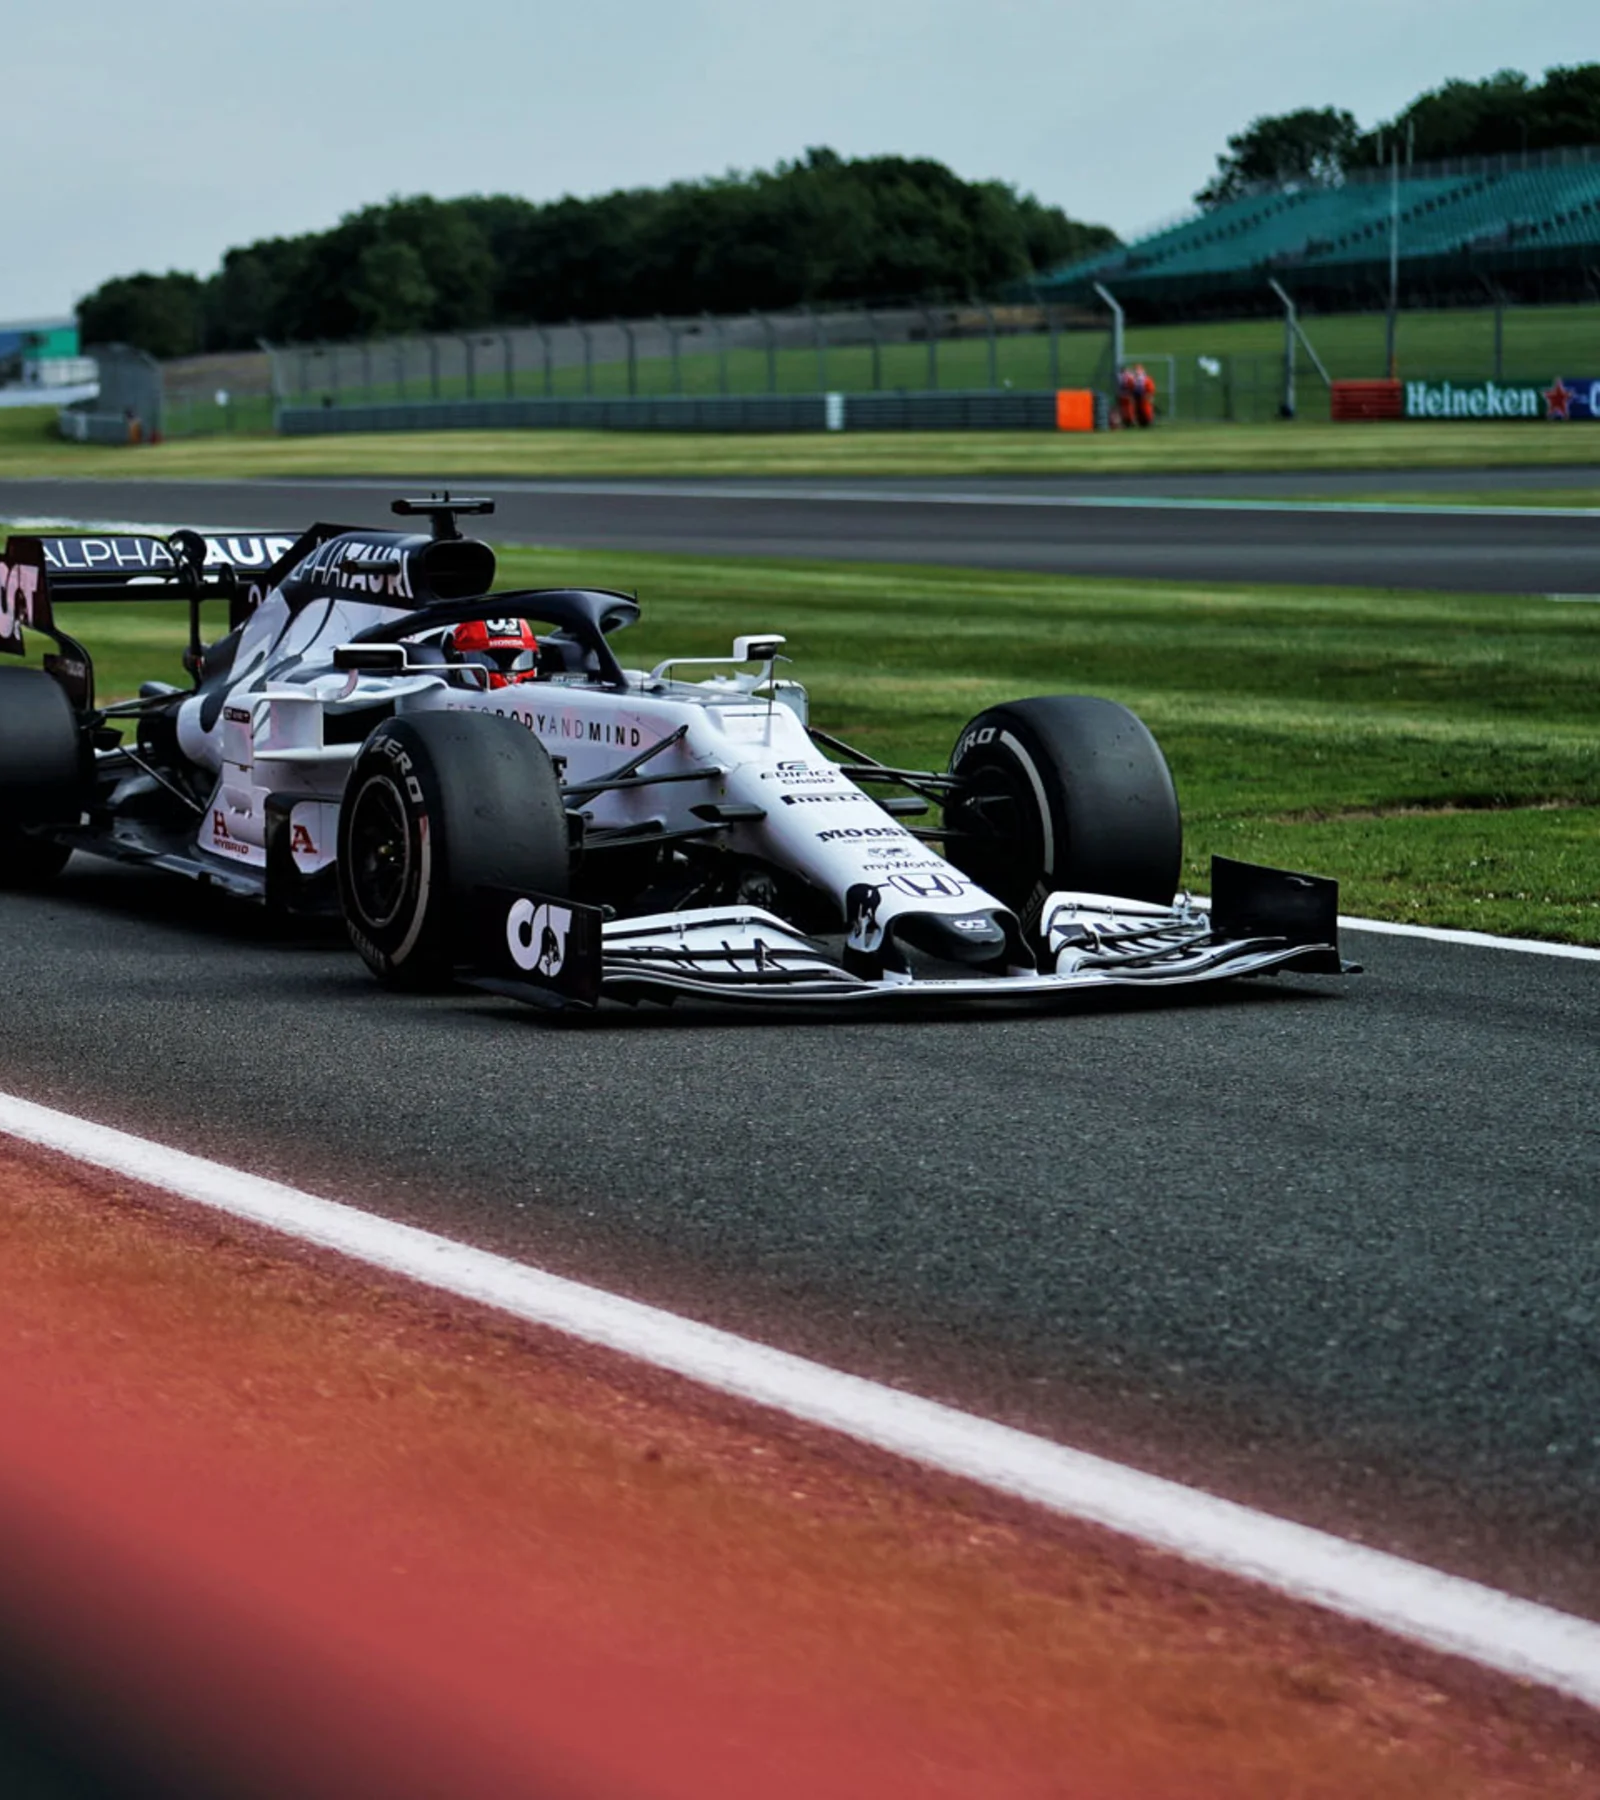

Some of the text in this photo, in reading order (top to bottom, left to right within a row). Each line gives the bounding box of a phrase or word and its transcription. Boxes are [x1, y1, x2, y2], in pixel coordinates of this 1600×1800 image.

[1406, 379, 1538, 417] Heineken
[370, 734, 424, 803] ZERO
[212, 838, 249, 854] HYBRID
